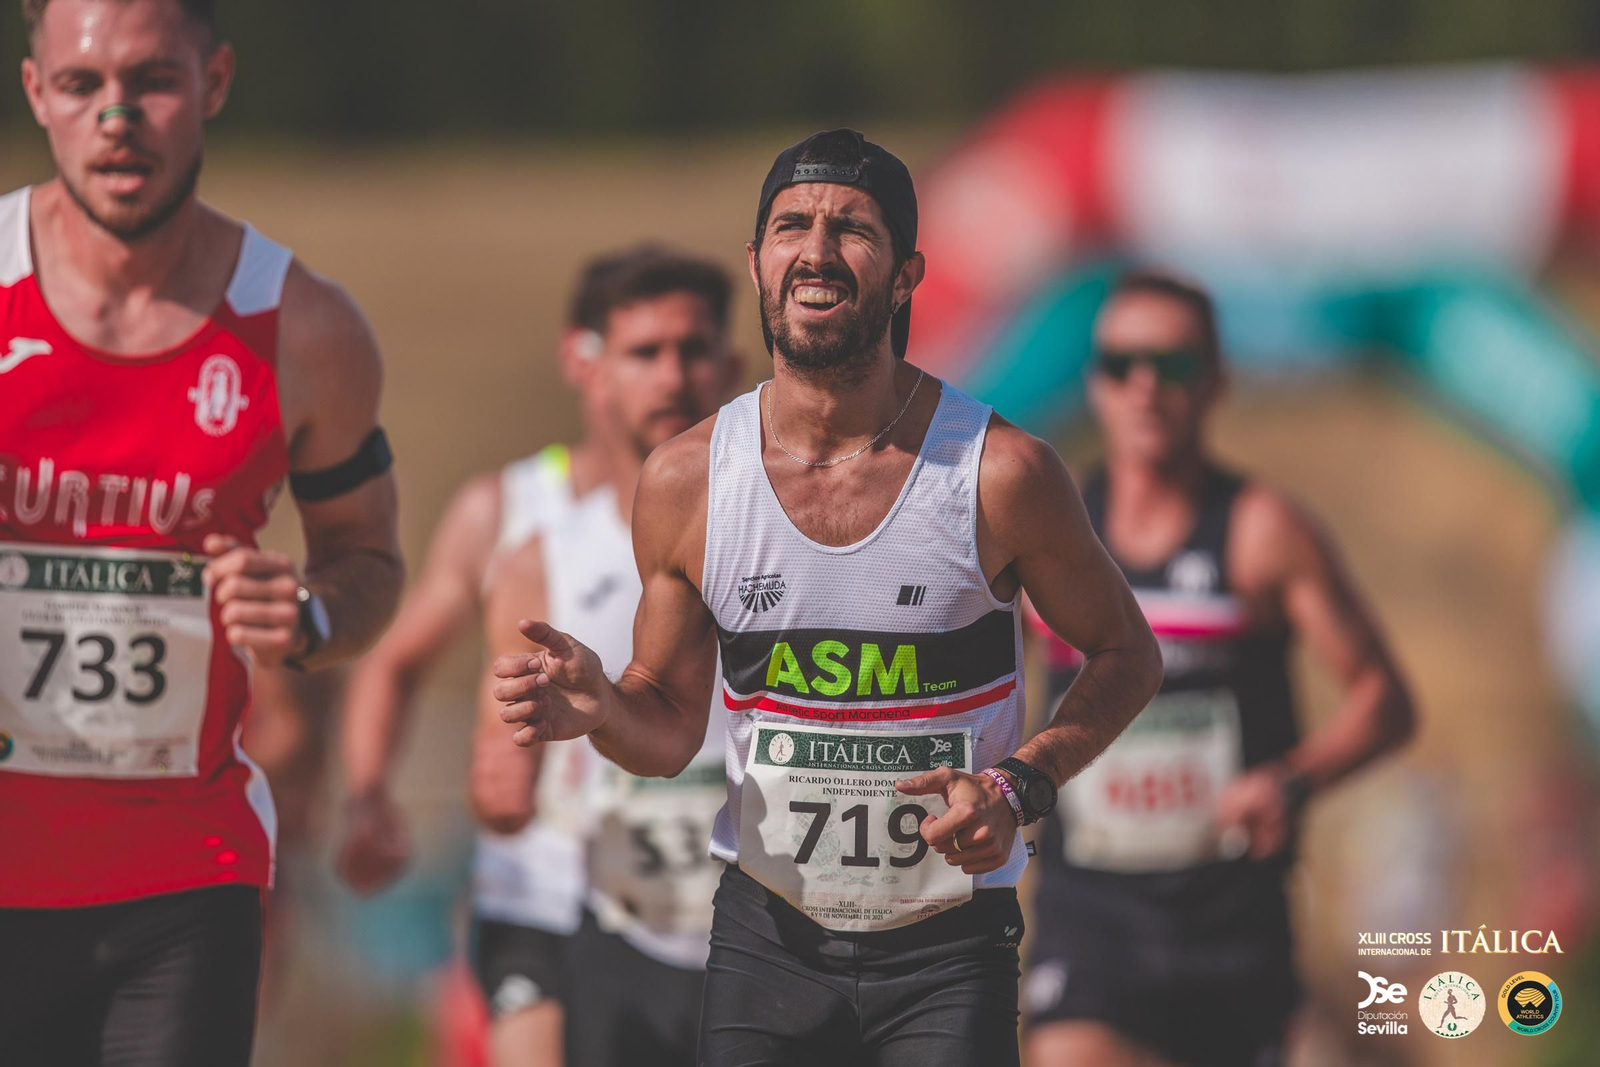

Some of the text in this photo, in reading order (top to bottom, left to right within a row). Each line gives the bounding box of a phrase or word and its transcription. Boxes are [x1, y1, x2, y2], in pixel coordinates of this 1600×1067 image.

[0, 457, 217, 538] URTIUS
[738, 580, 787, 594] HACHEMUDA
[20, 631, 168, 705] 733
[766, 641, 920, 696] ASM
[922, 680, 957, 693] Team
[776, 703, 911, 720] Athletic Sport Marchena
[808, 738, 914, 765] ITÁLICA
[808, 762, 859, 770] INTERNATIONAL
[929, 760, 953, 769] Sevilla
[788, 775, 900, 788] RICARDO OLLERO DOM
[822, 787, 898, 798] INDEPENDIENTE
[789, 801, 929, 868] 719
[819, 906, 862, 914] INTERNACIONAL
